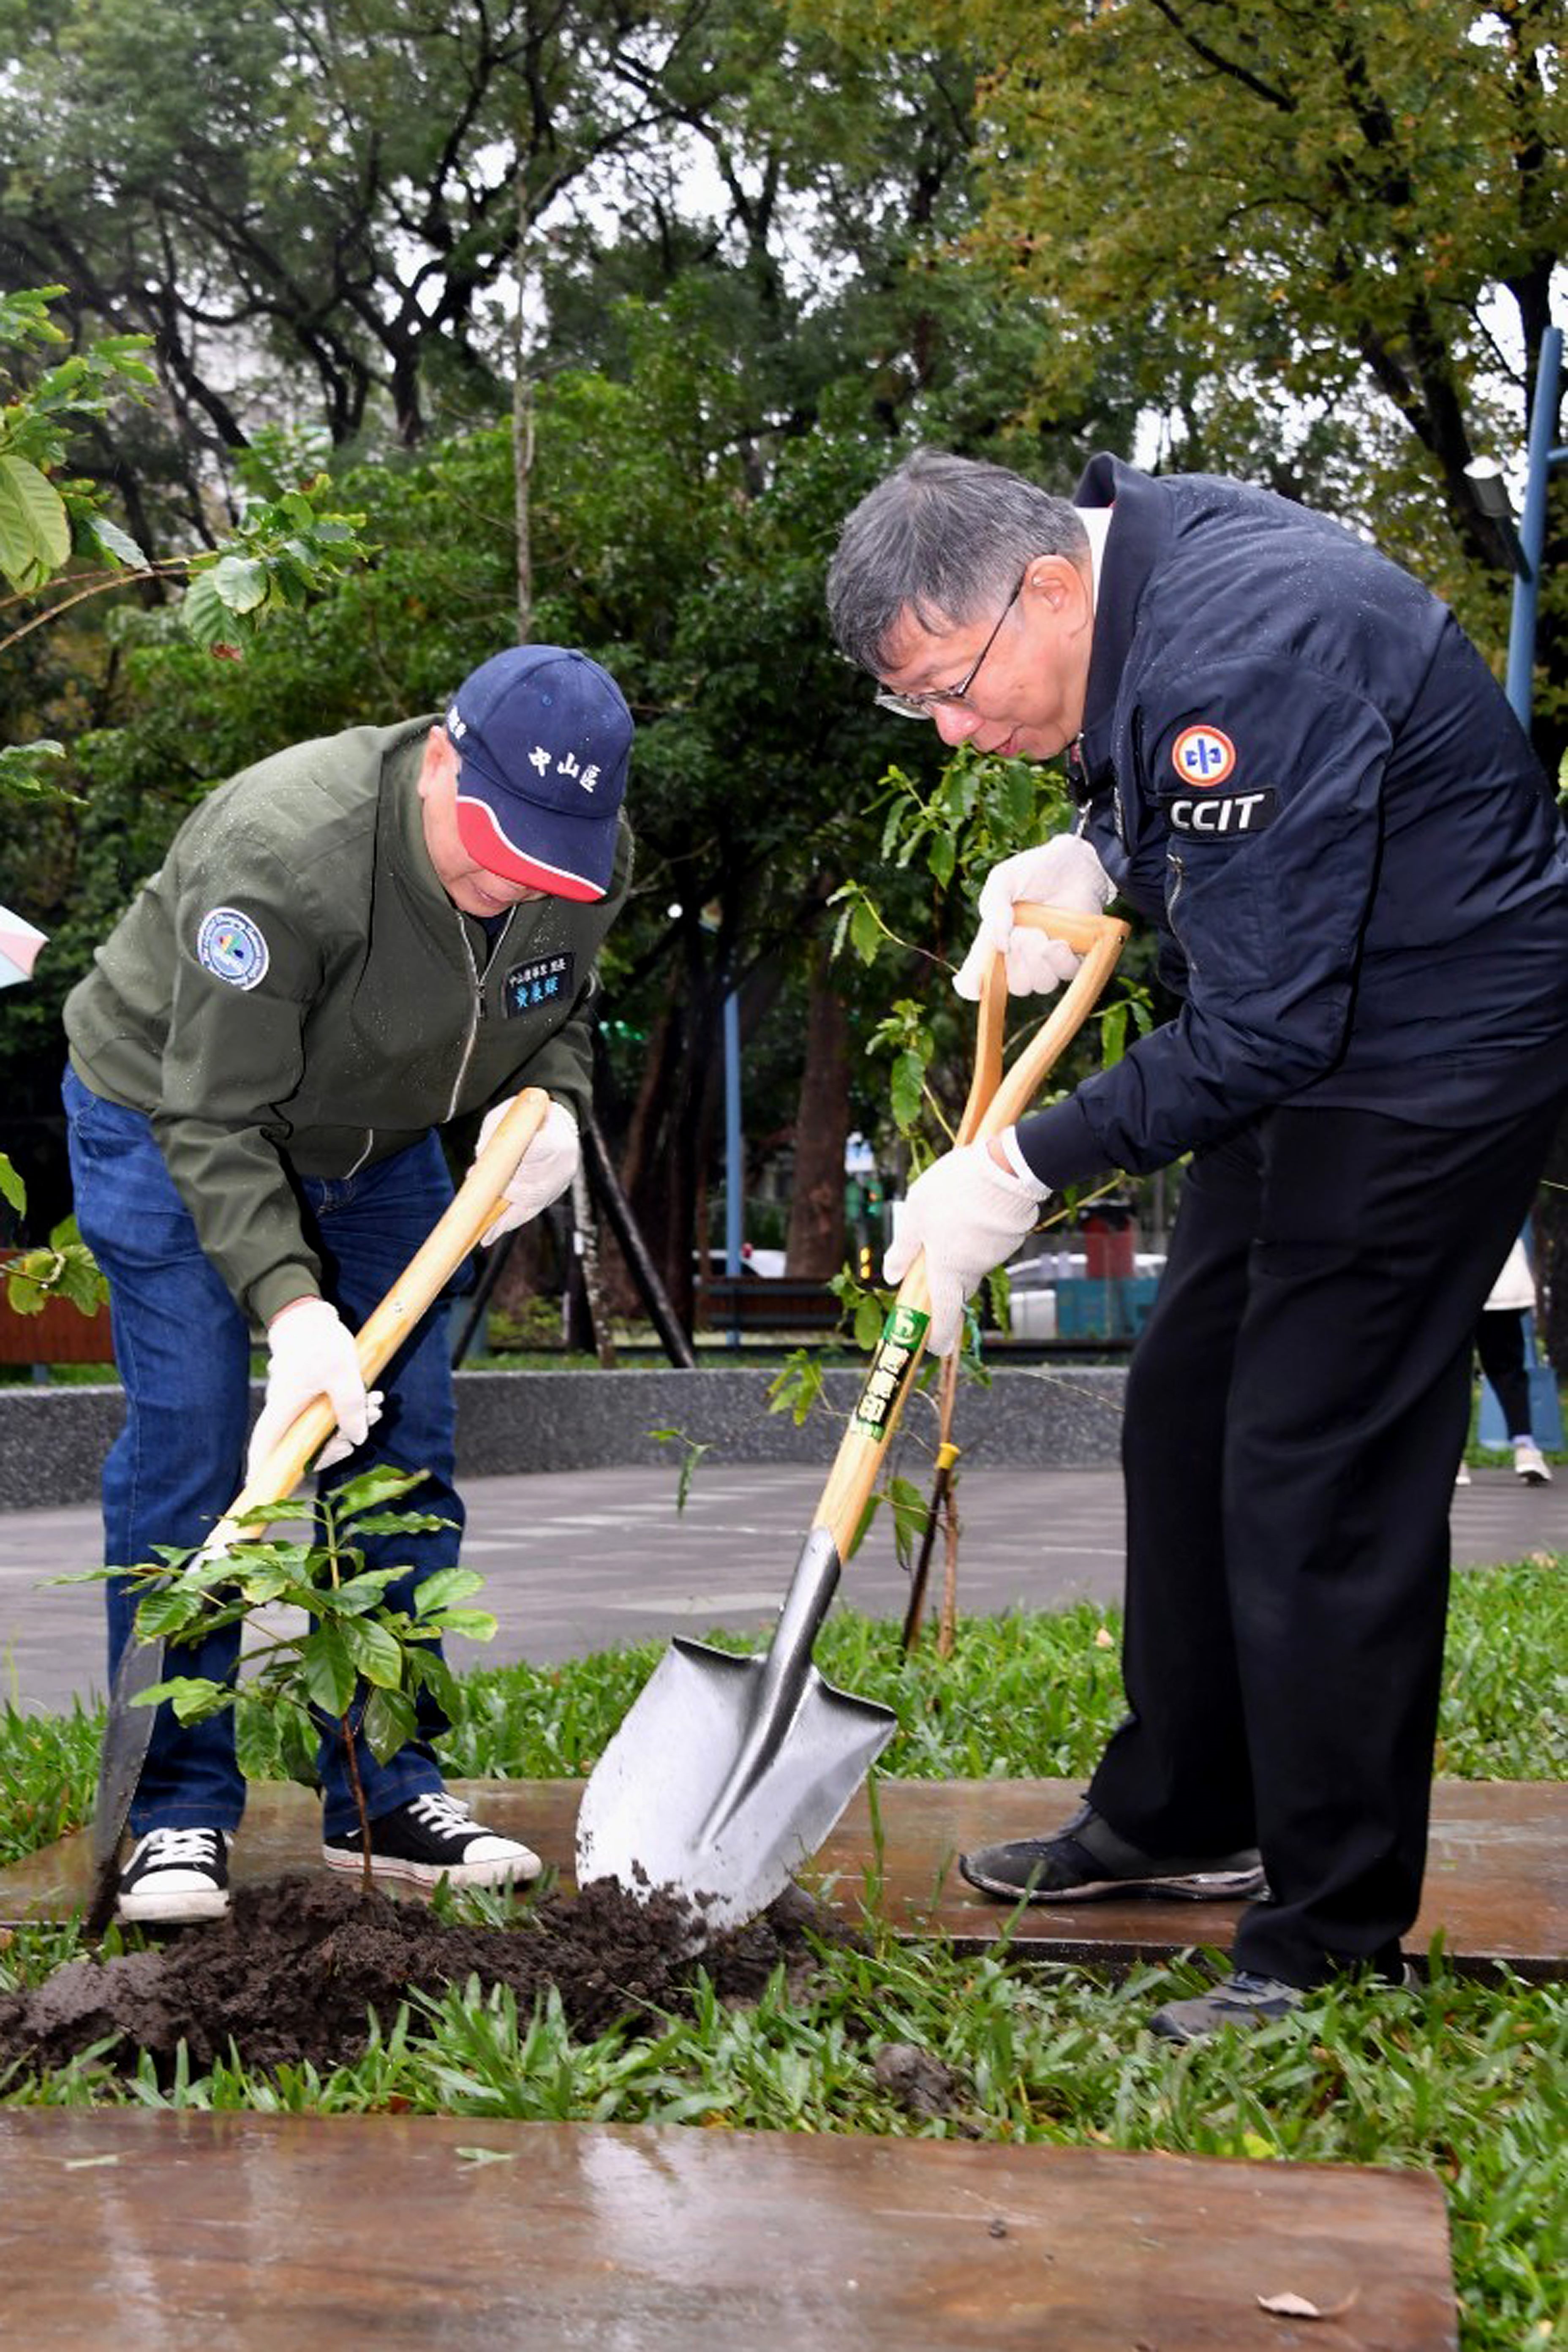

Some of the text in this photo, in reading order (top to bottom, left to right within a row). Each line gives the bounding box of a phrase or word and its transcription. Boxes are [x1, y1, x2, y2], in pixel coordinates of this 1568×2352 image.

[528, 746, 602, 794] 中山區
[1170, 794, 1265, 831] CCIT
